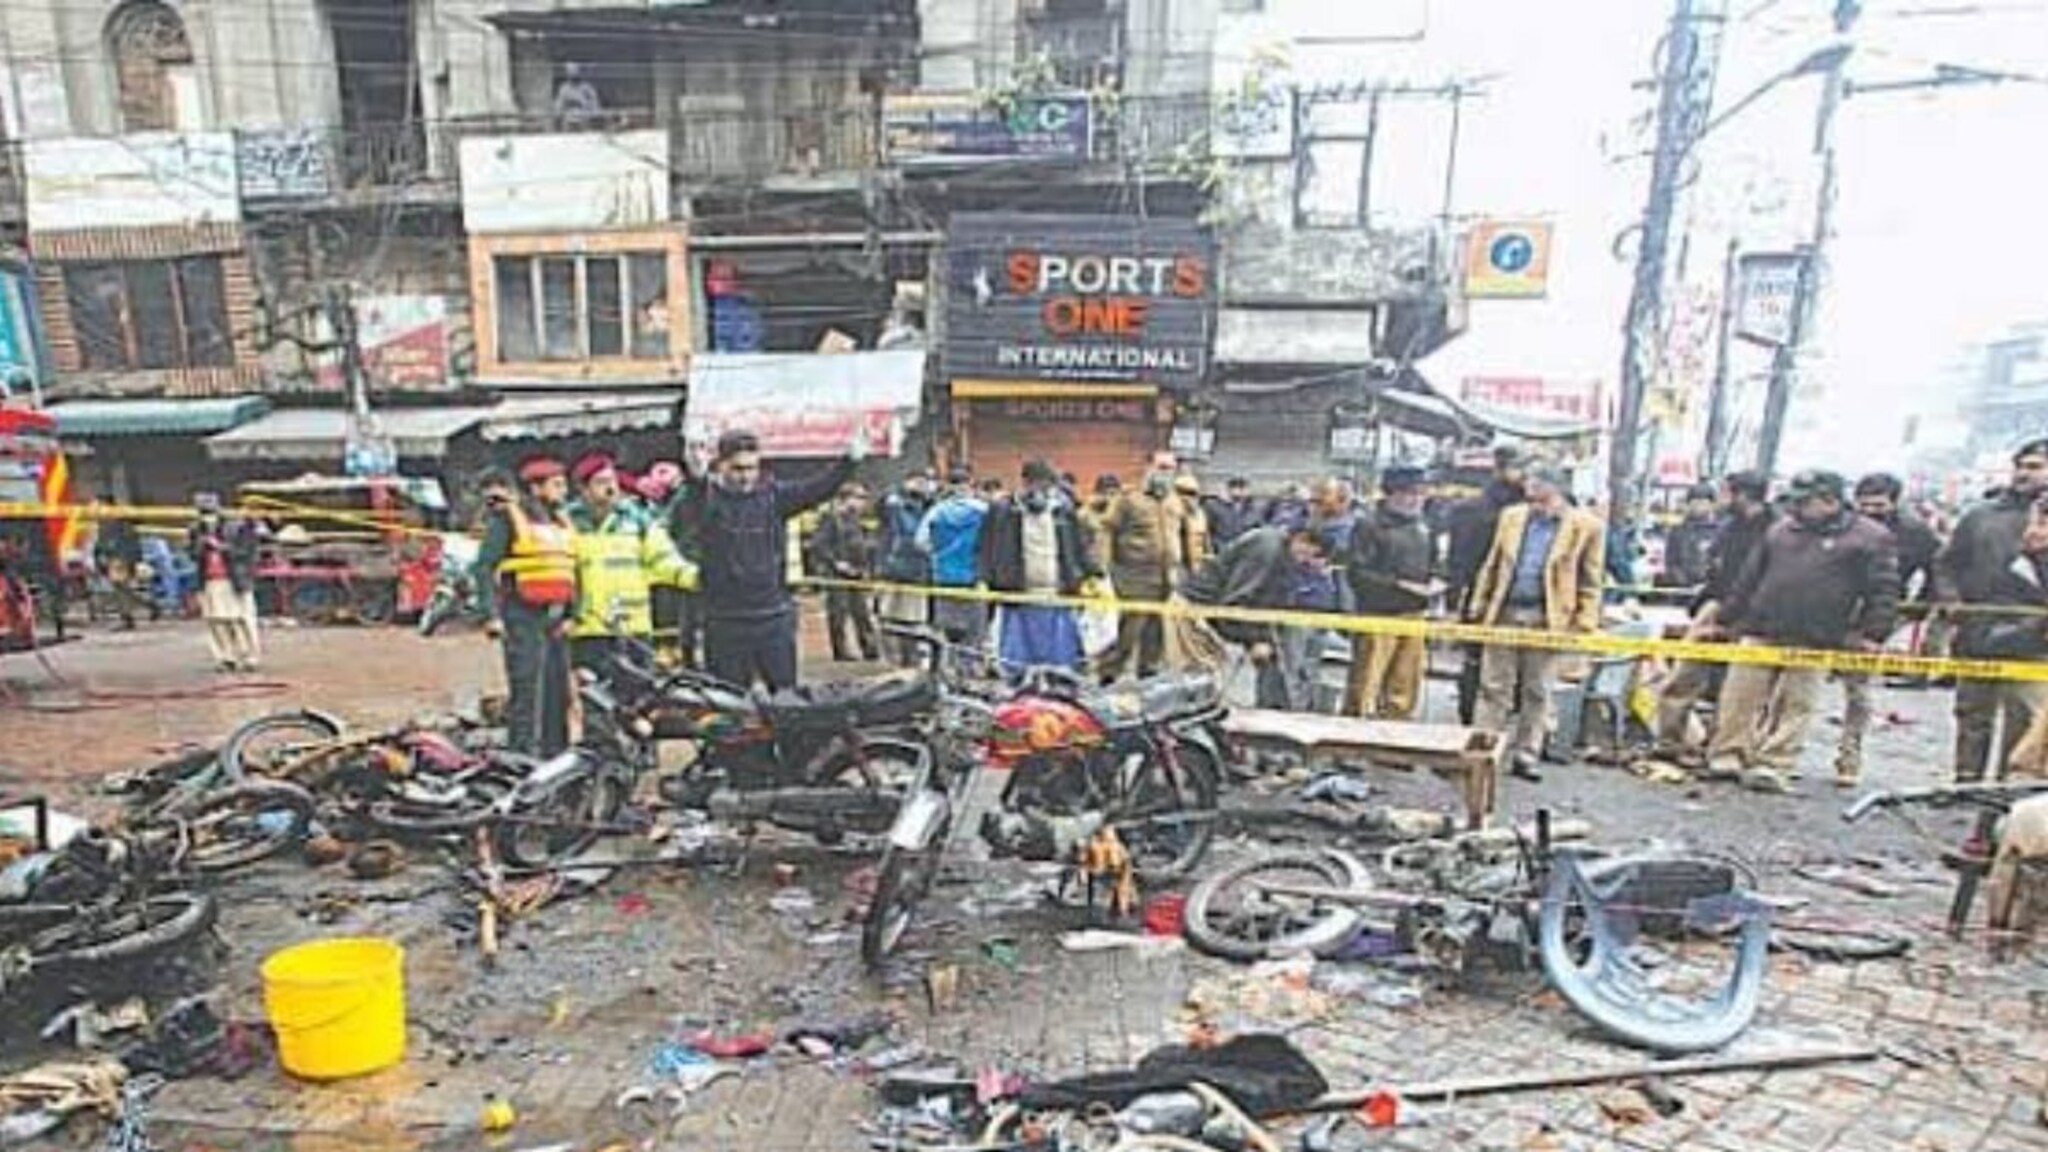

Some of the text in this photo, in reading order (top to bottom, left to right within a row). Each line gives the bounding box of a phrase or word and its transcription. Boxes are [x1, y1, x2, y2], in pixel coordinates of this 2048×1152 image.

[1009, 248, 1205, 297] SPORTS
[1043, 296, 1149, 339] ONE
[998, 347, 1193, 369] INTERNATIONAL
